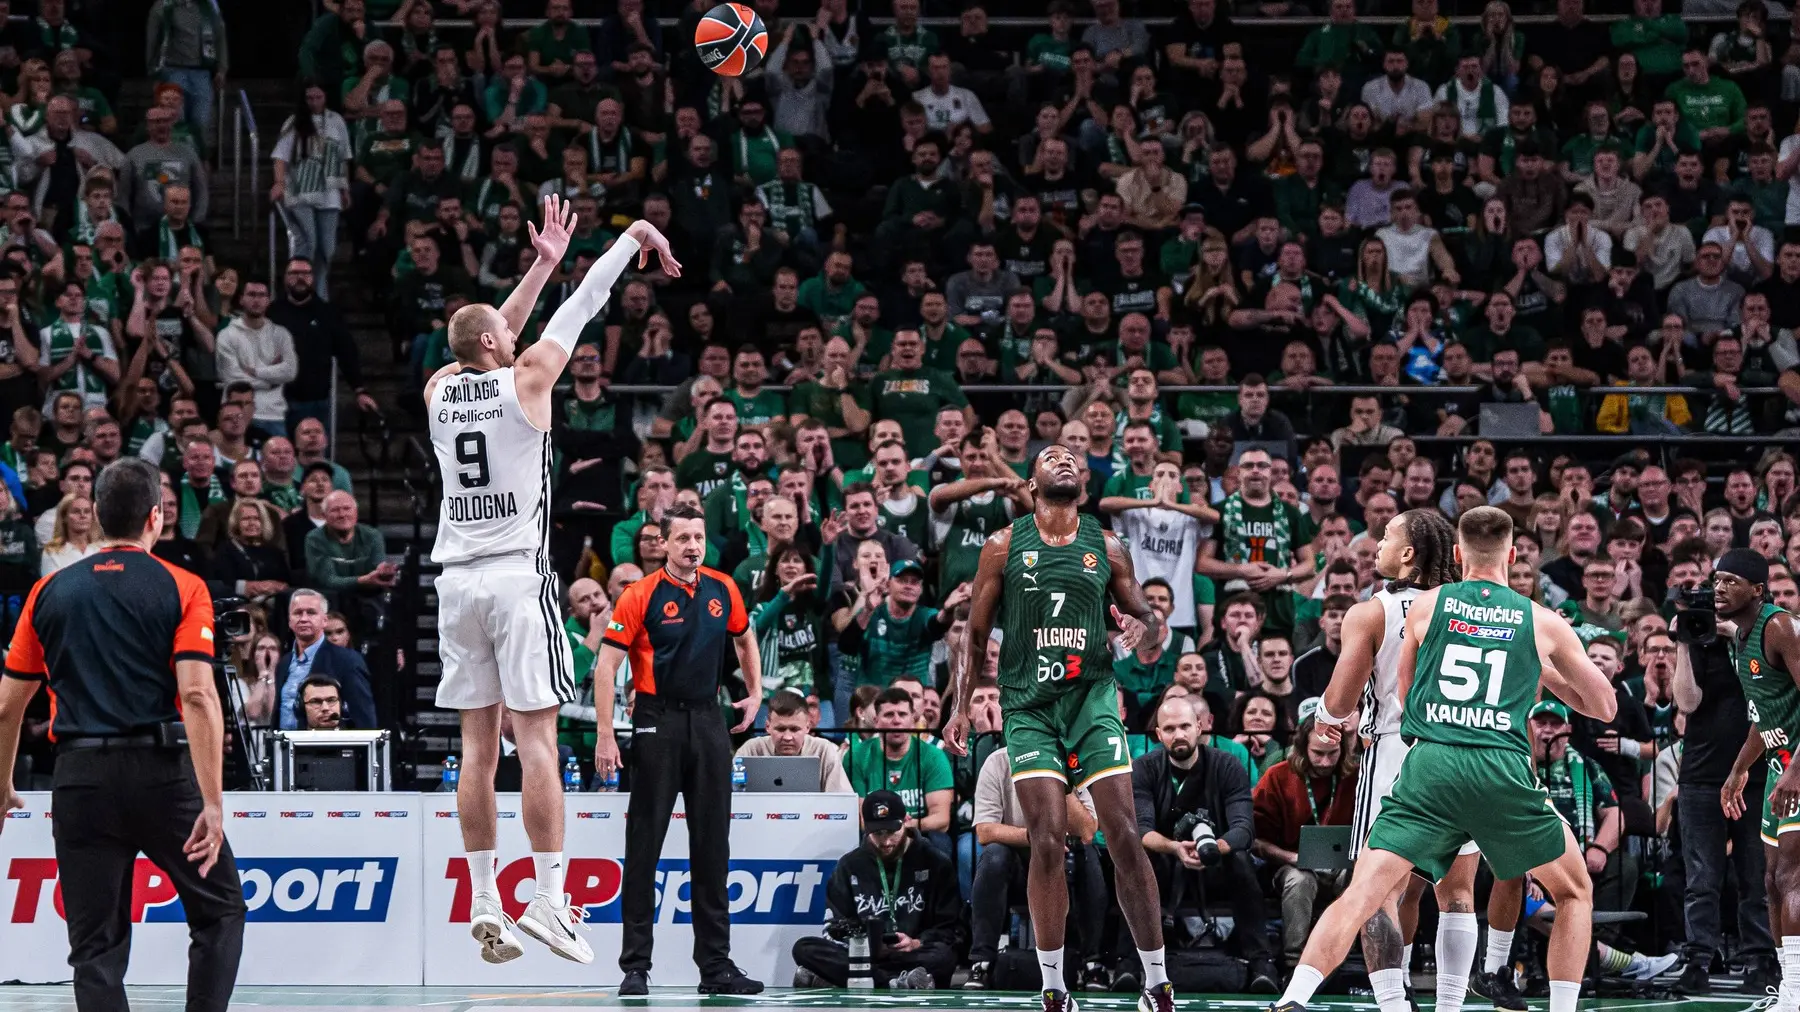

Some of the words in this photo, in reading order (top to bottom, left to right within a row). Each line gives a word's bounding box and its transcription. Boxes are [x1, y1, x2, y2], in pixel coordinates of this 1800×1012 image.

[452, 404, 503, 424] Pelliconi
[455, 430, 491, 489] 9
[449, 491, 518, 522] BOLOGNA
[1050, 592, 1066, 617] 7
[1443, 597, 1524, 624] BUTKEVIČIUS
[1448, 618, 1515, 641] TOPsport
[1437, 643, 1508, 707] 51
[1425, 702, 1512, 731] KAUNAS
[1107, 736, 1122, 761] 7
[7, 857, 384, 923] TPport
